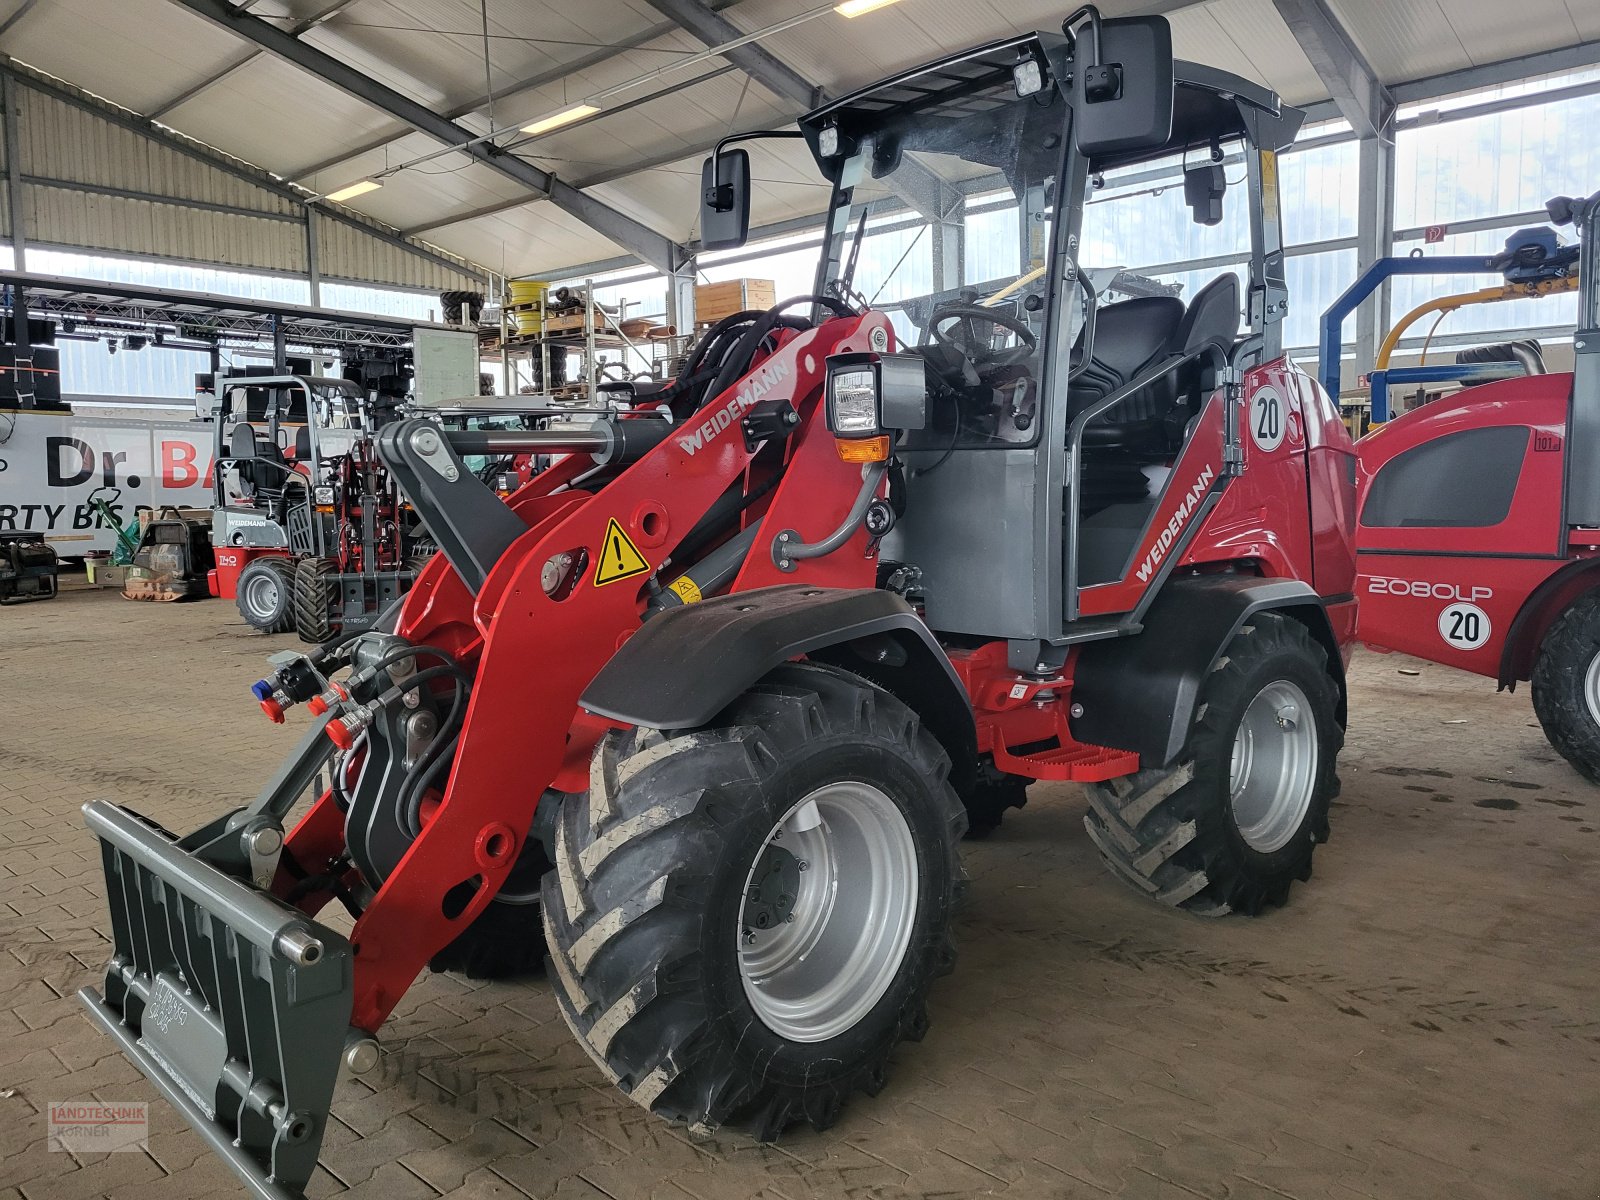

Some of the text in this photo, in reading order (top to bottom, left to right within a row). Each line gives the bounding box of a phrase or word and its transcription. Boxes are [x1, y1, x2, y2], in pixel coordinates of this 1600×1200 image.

[680, 358, 789, 456] WEIDEMANN
[1257, 397, 1279, 440] 20
[1537, 437, 1552, 450] 101
[46, 436, 141, 489] Dr.
[228, 519, 266, 528] WEIDEMANN
[1136, 463, 1214, 582] WEIDEMANN
[1368, 577, 1493, 602] 2080LP
[1449, 610, 1480, 642] 20
